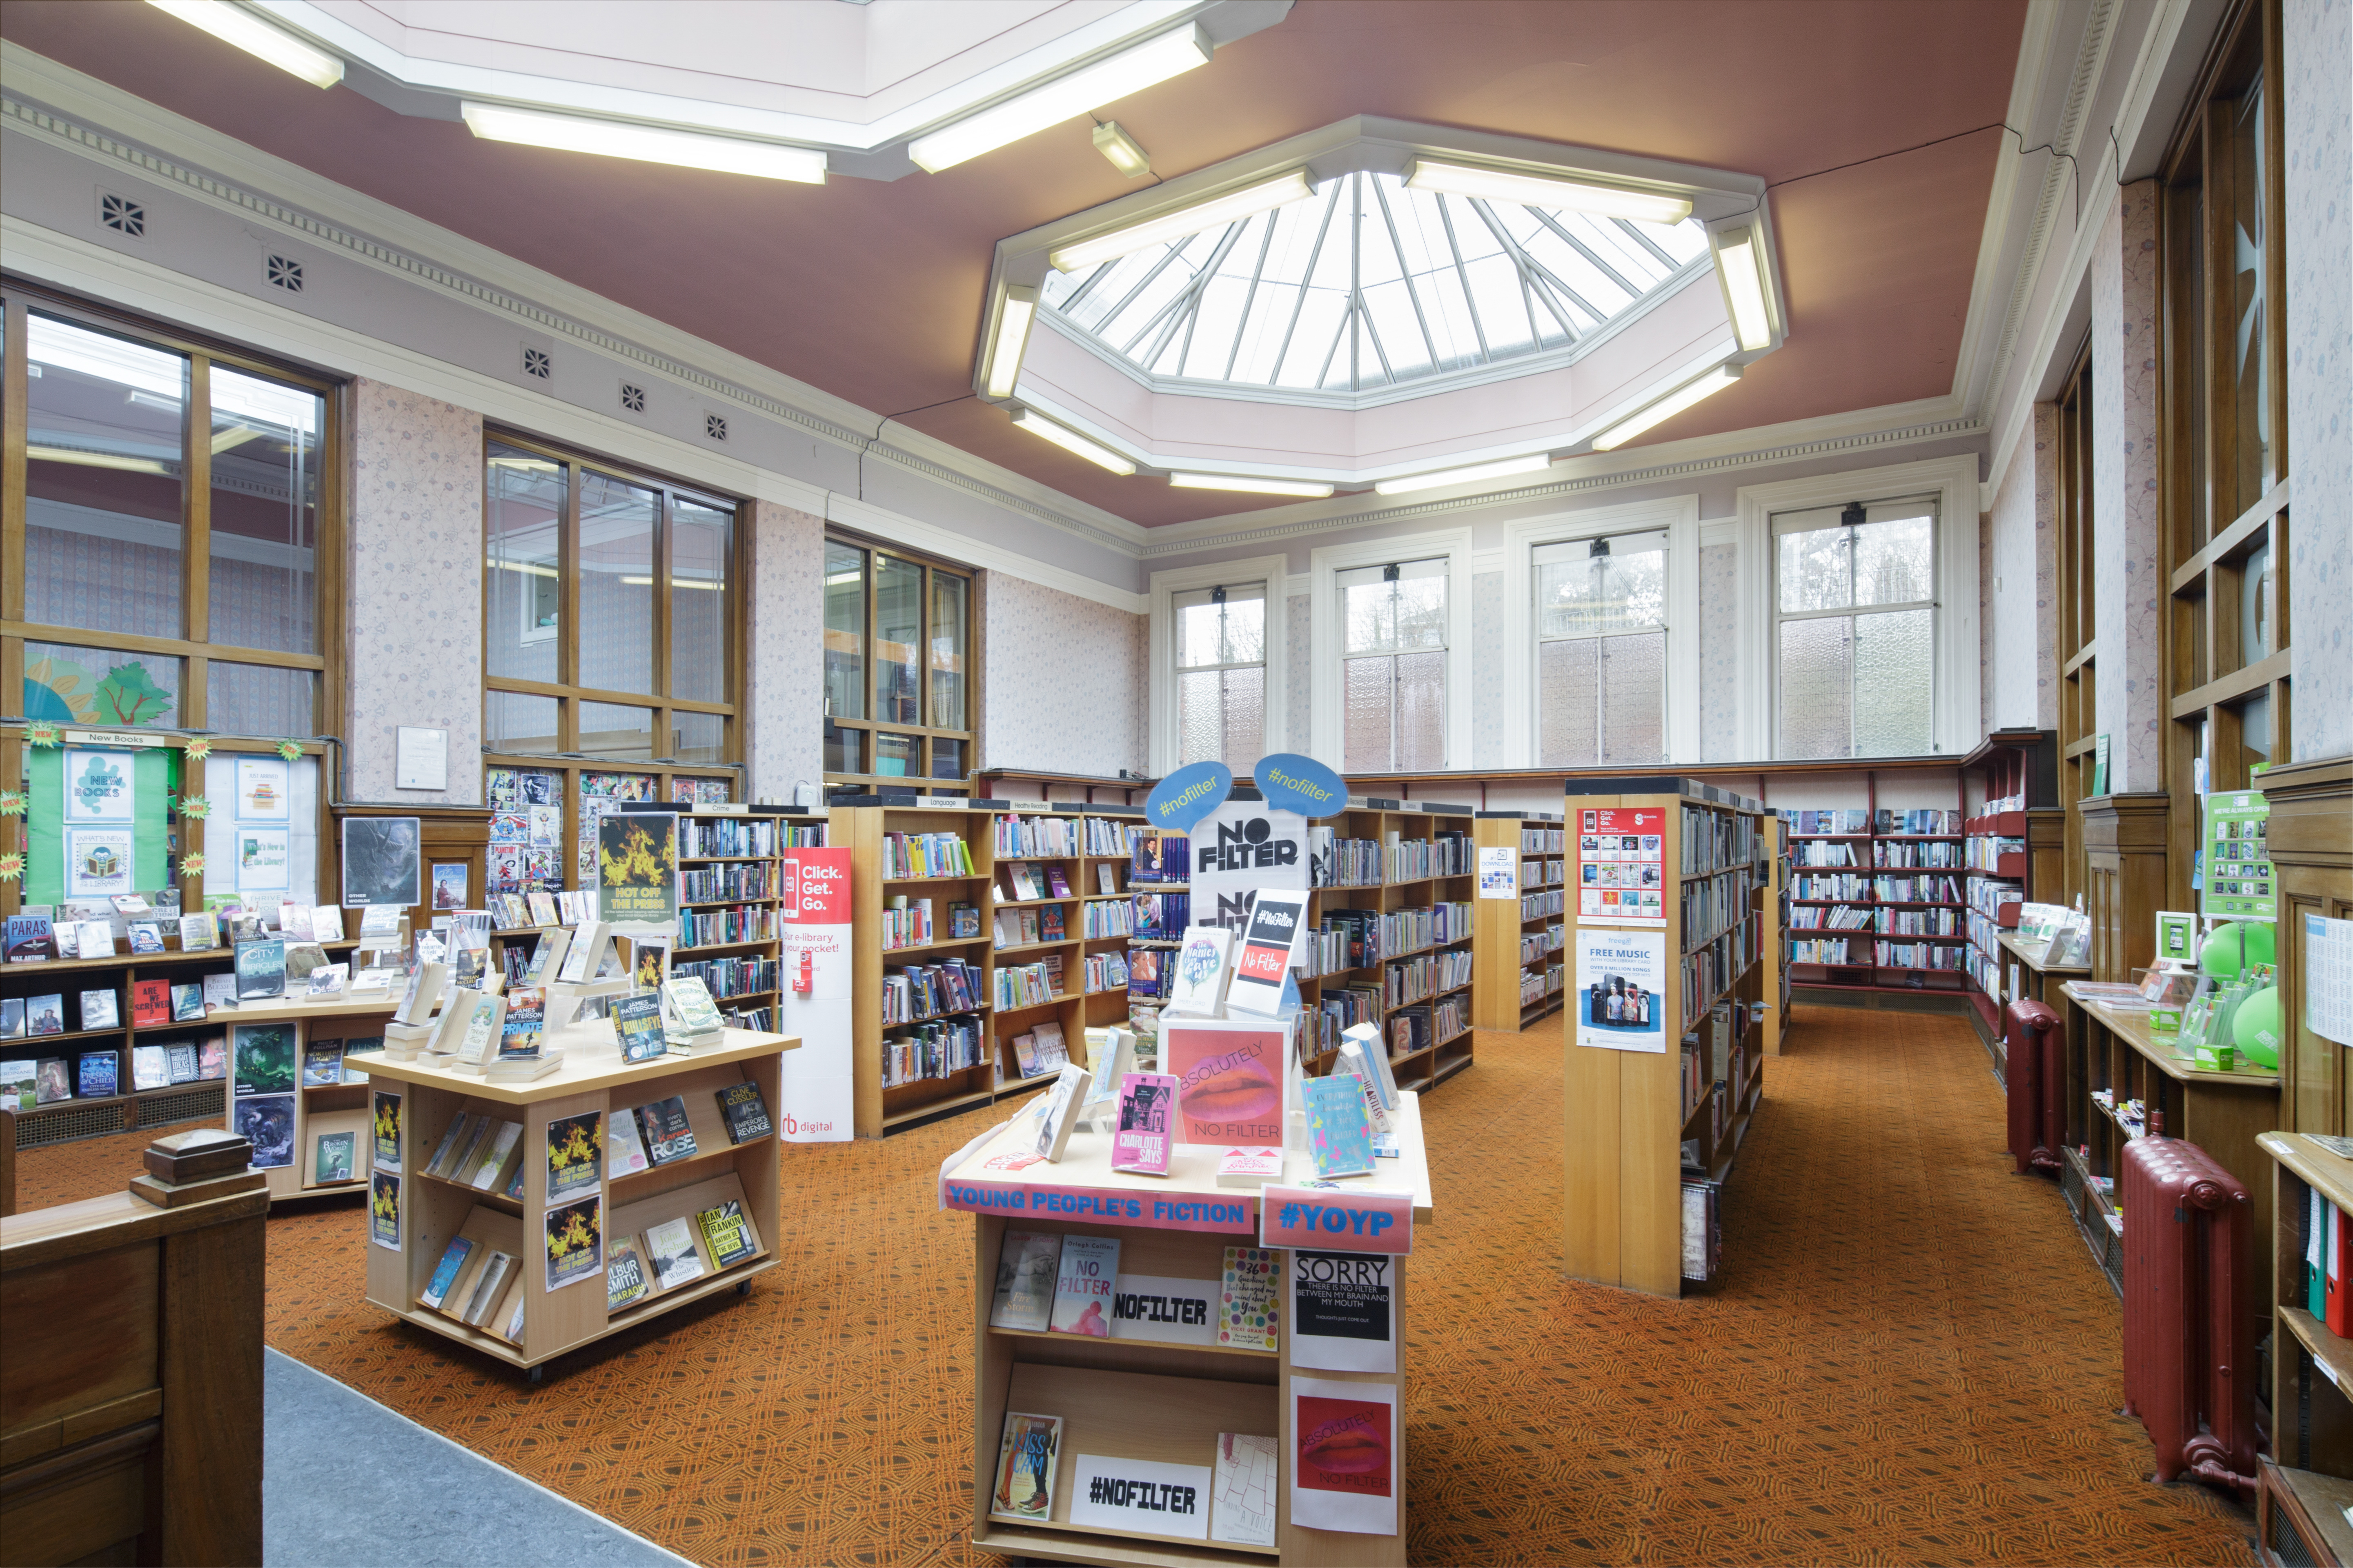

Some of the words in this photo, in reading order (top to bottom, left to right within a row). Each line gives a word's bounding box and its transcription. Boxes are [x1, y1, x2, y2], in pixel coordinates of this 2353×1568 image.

[91, 776, 122, 785] NEW
[1268, 768, 1333, 803] #nofilter
[74, 787, 119, 797] BOOKS
[1159, 776, 1217, 817] #nofilter
[2, 798, 20, 807] NEW
[930, 798, 956, 807] Language
[1218, 818, 1270, 845] NO
[1199, 839, 1298, 873] FILTER
[802, 866, 842, 879] Click.
[616, 887, 638, 898] HOT
[640, 887, 661, 897] OFF
[802, 881, 833, 894] Get.
[611, 899, 630, 909] THE
[634, 899, 665, 909] PRESS
[802, 897, 826, 910] Go.
[1257, 910, 1293, 927] #NoFilter
[12, 921, 46, 935] PARAS
[785, 932, 793, 940] Our
[795, 933, 833, 943] e-library
[248, 949, 274, 959] CITY
[787, 945, 800, 953] your
[803, 944, 839, 954] pocket!
[1187, 947, 1216, 958] Names
[1616, 950, 1650, 959] MUSIC
[240, 961, 283, 970] MIRACLES
[1185, 958, 1216, 975] Gave
[1244, 952, 1255, 968] No
[1257, 953, 1281, 972] Filter
[143, 987, 157, 995] ARE
[135, 1001, 169, 1010] SCREWED
[621, 1003, 657, 1014] PATTERSON
[628, 1000, 648, 1008] JAMES
[502, 1022, 542, 1035] PRIVATE
[623, 1015, 662, 1035] BULLSEYE
[727, 1092, 758, 1105] CUSSLER
[731, 1087, 749, 1097] CLIVE
[667, 1113, 682, 1121] every
[735, 1115, 767, 1129] EMPEROR'S
[669, 1123, 686, 1132] corner
[737, 1121, 770, 1137] REVENGE
[801, 1122, 832, 1133] digital
[1195, 1123, 1220, 1136] NO
[1227, 1124, 1279, 1138] FILTER
[657, 1129, 690, 1143] Karen
[1120, 1134, 1163, 1150] CHARLOTTE
[323, 1140, 348, 1148] BROKEN
[650, 1133, 697, 1161] ROSE
[1139, 1148, 1162, 1164] SAYS
[559, 1166, 576, 1177] HOT
[577, 1162, 592, 1173] OFF
[557, 1174, 570, 1185] THE
[572, 1169, 594, 1181] PRESS
[949, 1185, 1025, 1209] YOUNG
[1032, 1192, 1141, 1217] PEOPLE'S
[1154, 1201, 1244, 1223] FICTION
[706, 1210, 721, 1222] IAN
[1280, 1201, 1394, 1236] #YOYP
[711, 1217, 741, 1234] RANKIN
[659, 1232, 681, 1246] John
[715, 1232, 730, 1244] RATHER
[655, 1239, 692, 1257] Grisham
[727, 1241, 739, 1252] DEVIL
[559, 1252, 575, 1265] HOT
[577, 1248, 591, 1259] OFF
[556, 1261, 570, 1273] THE
[572, 1255, 594, 1268] PRESS
[1075, 1260, 1099, 1277] NO
[1246, 1263, 1259, 1274] 36
[668, 1266, 695, 1280] Whistler
[1297, 1257, 1388, 1286] SORRY
[1060, 1277, 1111, 1296] FILTER
[1307, 1282, 1330, 1290] THERE
[1355, 1285, 1378, 1293] FILTER
[1013, 1292, 1031, 1303] Fire
[1297, 1290, 1332, 1298] BETWEEN
[1006, 1301, 1033, 1312] Storm
[1300, 1410, 1376, 1450] ABSOLUTELY
[1013, 1430, 1046, 1454] KISS
[1013, 1453, 1044, 1476] CAM
[1319, 1472, 1341, 1486] NO
[1346, 1474, 1389, 1490] FILTER
[1090, 1476, 1195, 1515] #NOFILTER
